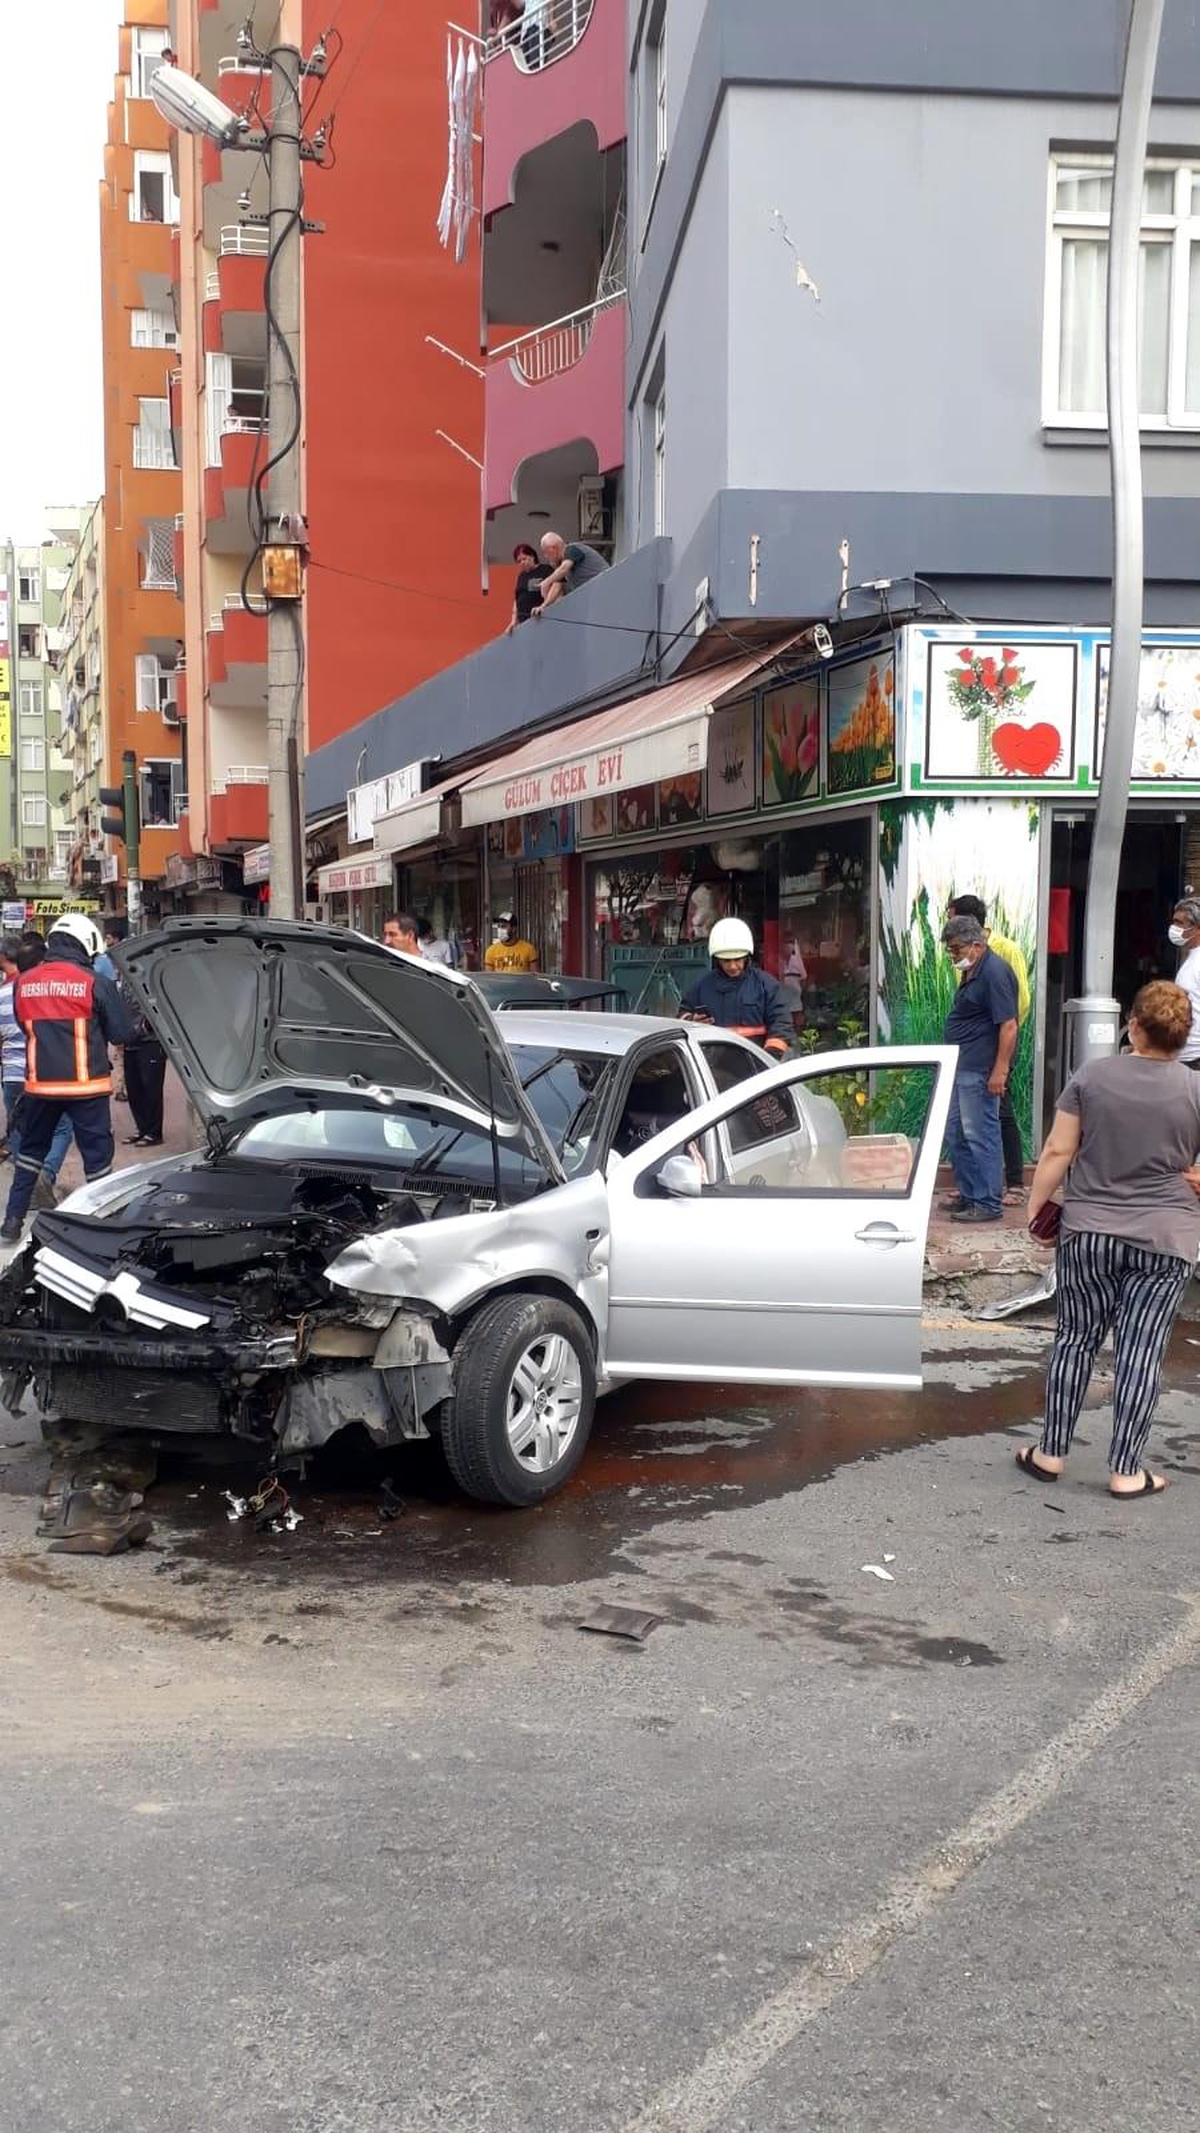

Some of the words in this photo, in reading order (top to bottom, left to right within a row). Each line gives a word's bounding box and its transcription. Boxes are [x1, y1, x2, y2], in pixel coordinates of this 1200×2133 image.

[504, 777, 541, 810] GÜLÜM
[550, 765, 588, 799] ÇİÇEK
[597, 747, 624, 786] EVİ
